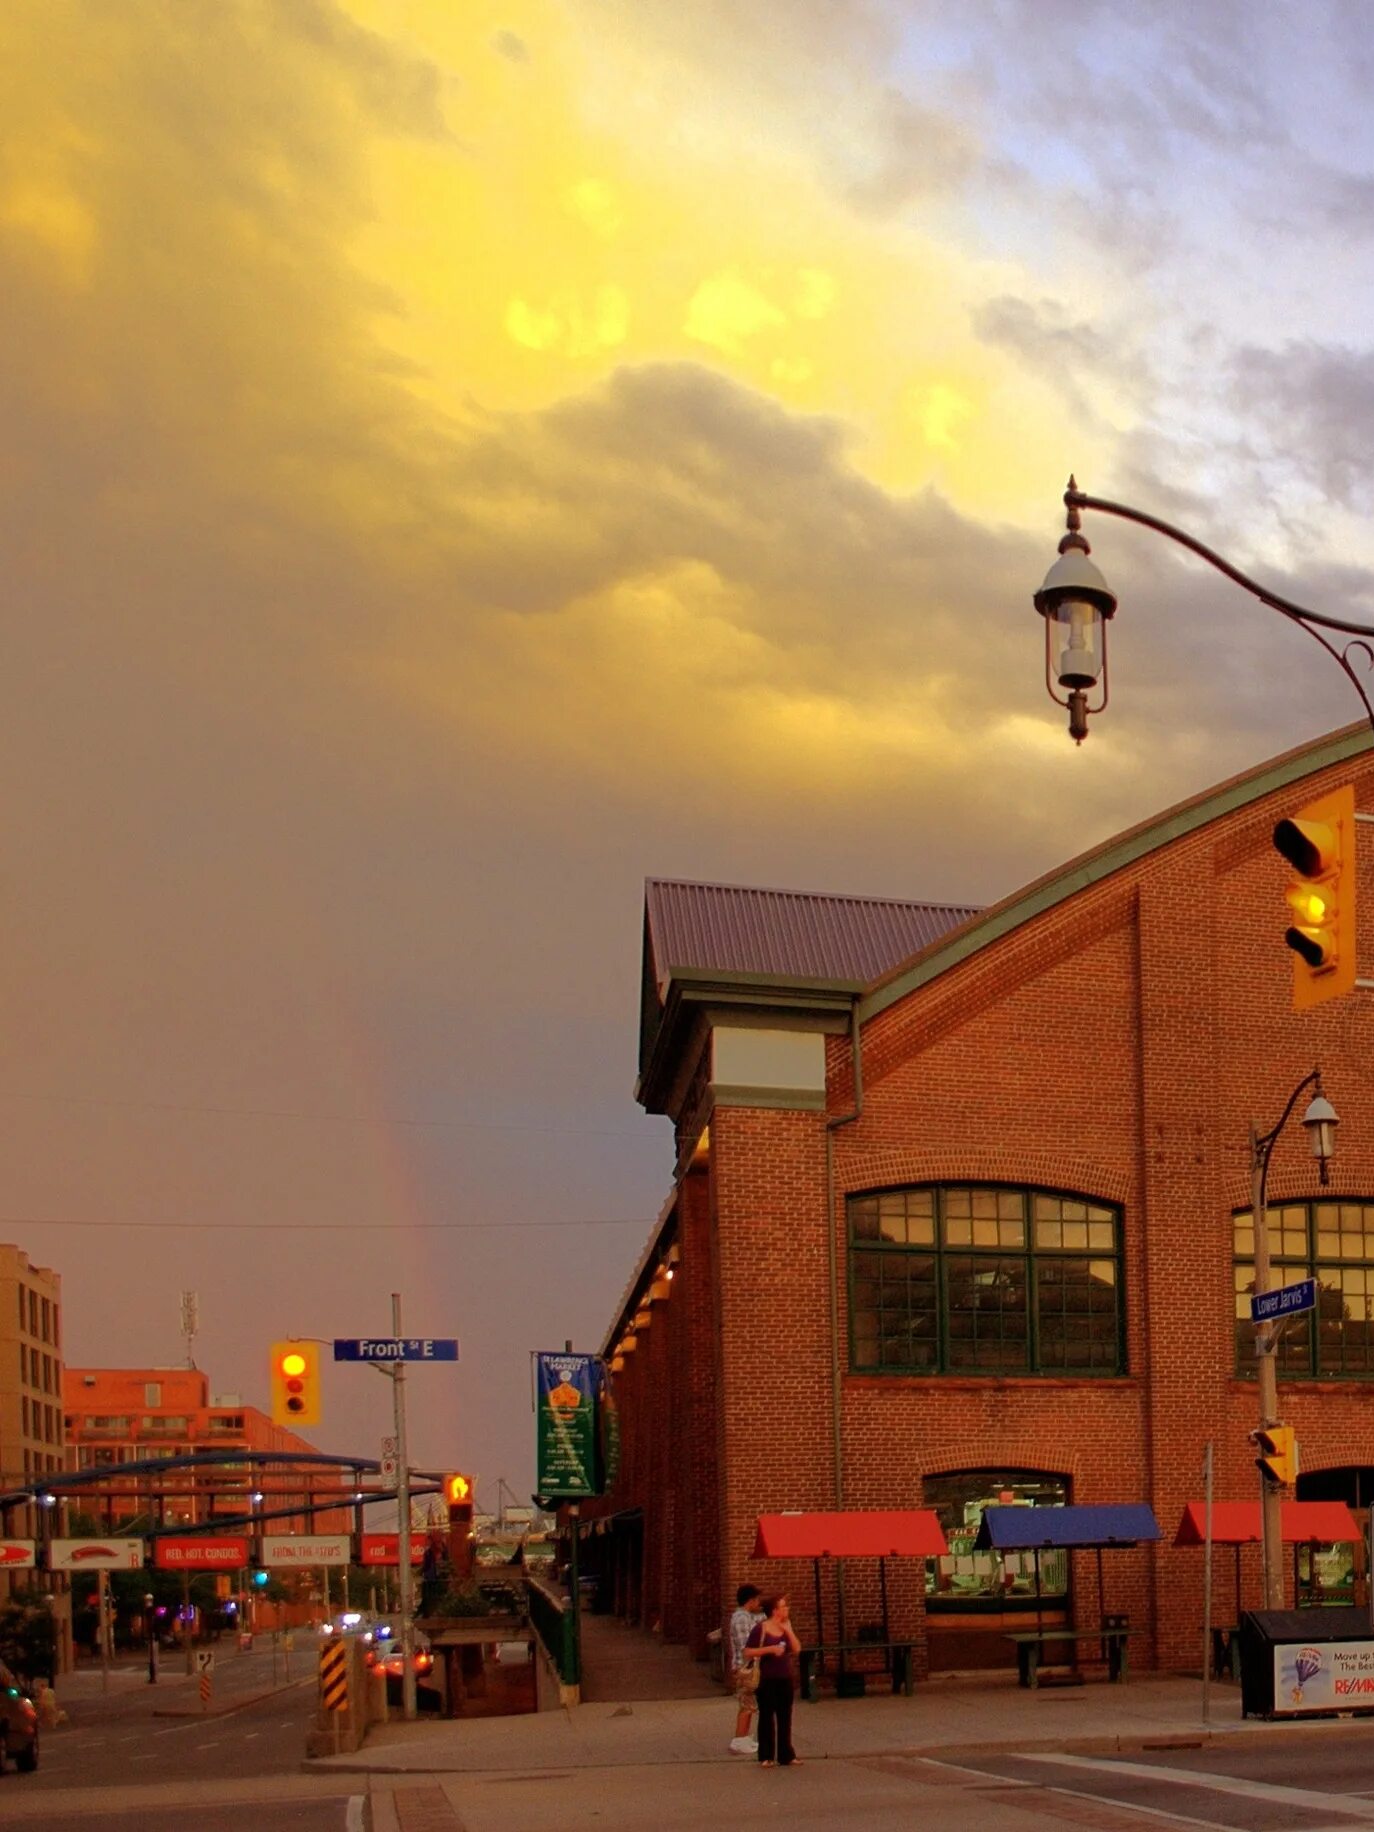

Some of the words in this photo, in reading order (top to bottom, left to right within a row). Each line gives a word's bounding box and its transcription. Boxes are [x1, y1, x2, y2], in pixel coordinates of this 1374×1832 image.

[1257, 1296, 1279, 1315] Lower
[1280, 1287, 1302, 1308] Jarvis
[359, 1340, 405, 1357] Front
[409, 1340, 419, 1350] St
[423, 1340, 433, 1356] E
[1333, 1652, 1357, 1661] Move
[1360, 1652, 1371, 1662] up
[1340, 1663, 1357, 1672] The
